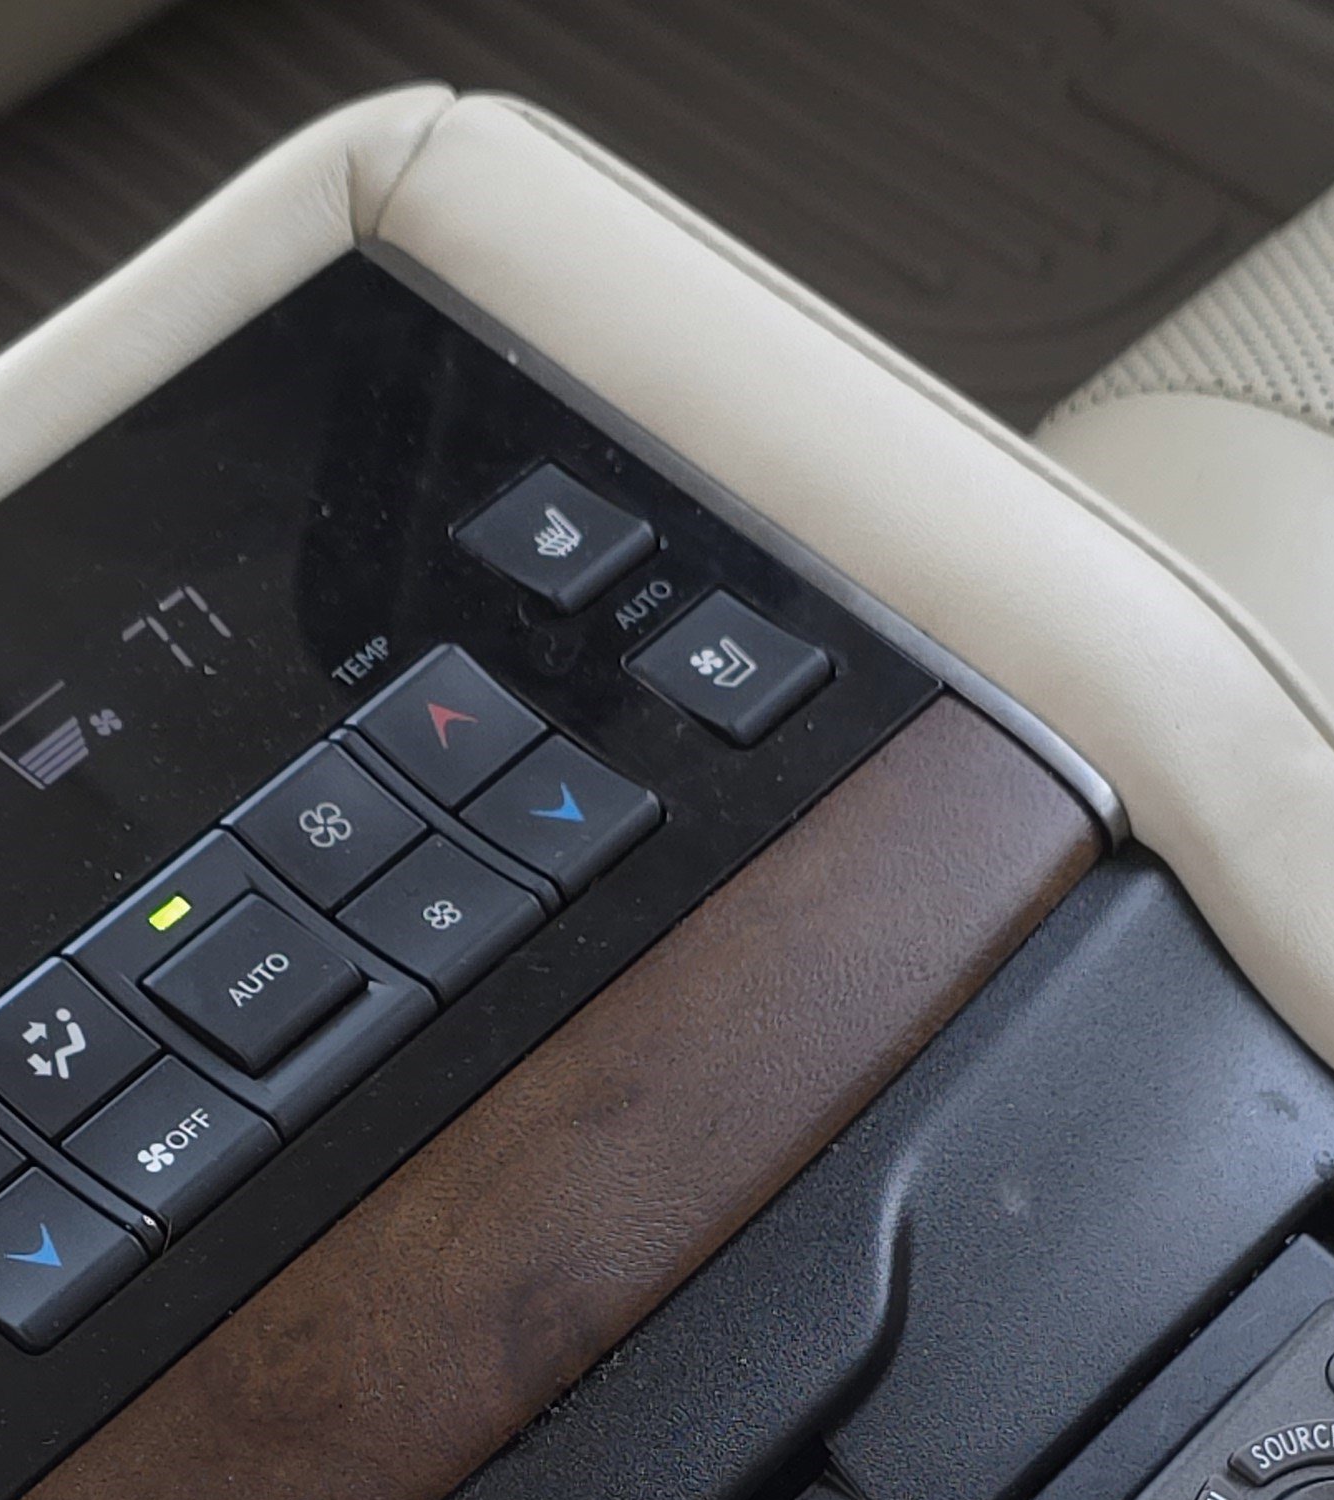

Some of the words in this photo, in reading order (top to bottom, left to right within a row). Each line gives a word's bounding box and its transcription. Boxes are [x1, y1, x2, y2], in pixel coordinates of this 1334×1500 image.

[122, 585, 231, 668] 77
[614, 579, 673, 632] AUTO
[331, 634, 391, 689] TEMP
[227, 951, 290, 1007] AUTO
[164, 1107, 212, 1152] OFF
